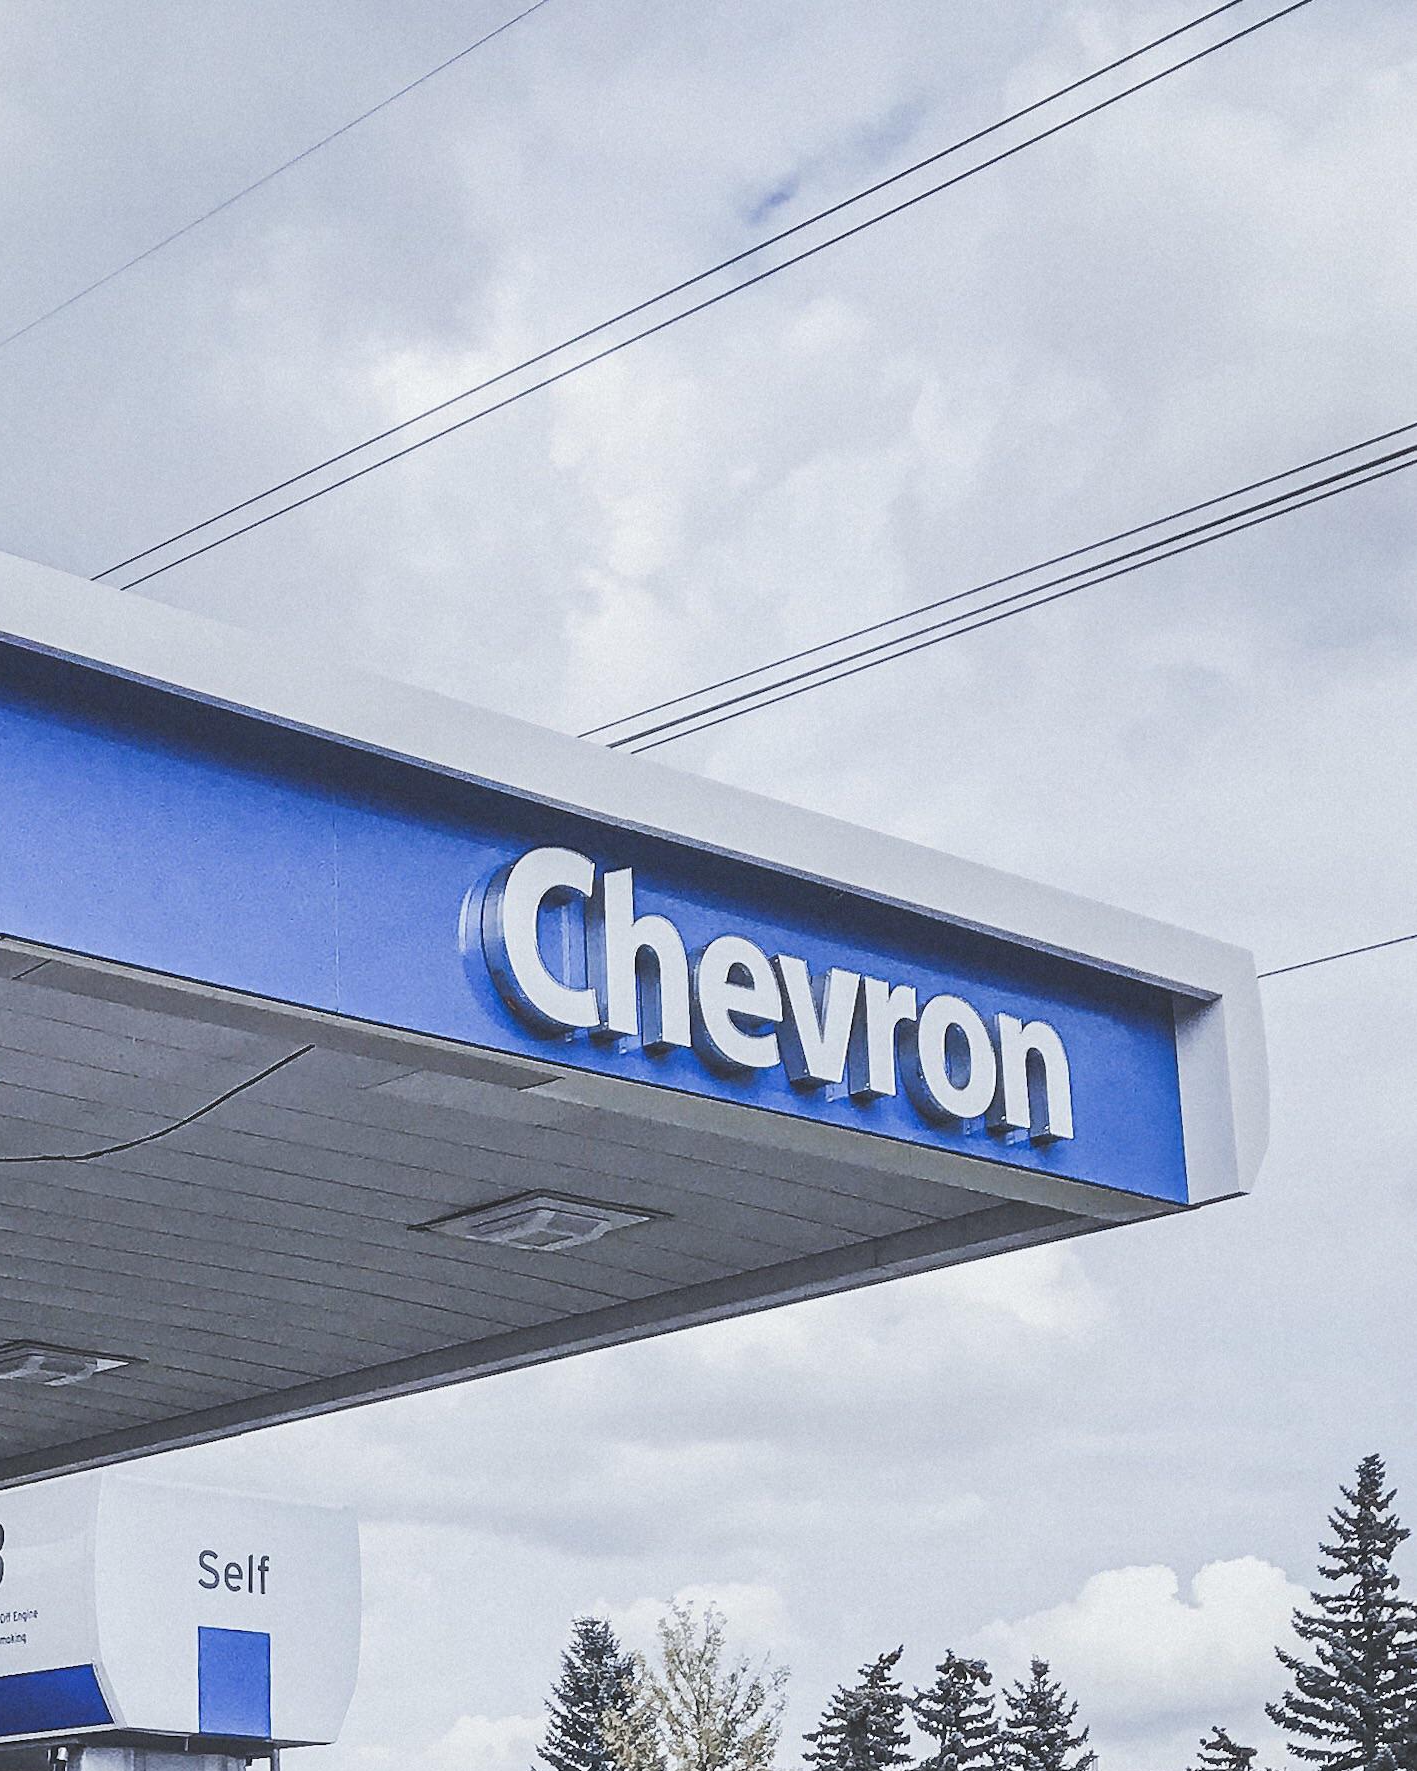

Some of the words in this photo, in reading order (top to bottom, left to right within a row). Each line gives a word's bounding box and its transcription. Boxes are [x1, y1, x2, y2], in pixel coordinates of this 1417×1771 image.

[484, 846, 1074, 1141] Chevron
[198, 1549, 270, 1595] Self
[0, 1611, 11, 1624] Off
[13, 1608, 39, 1623] Engine
